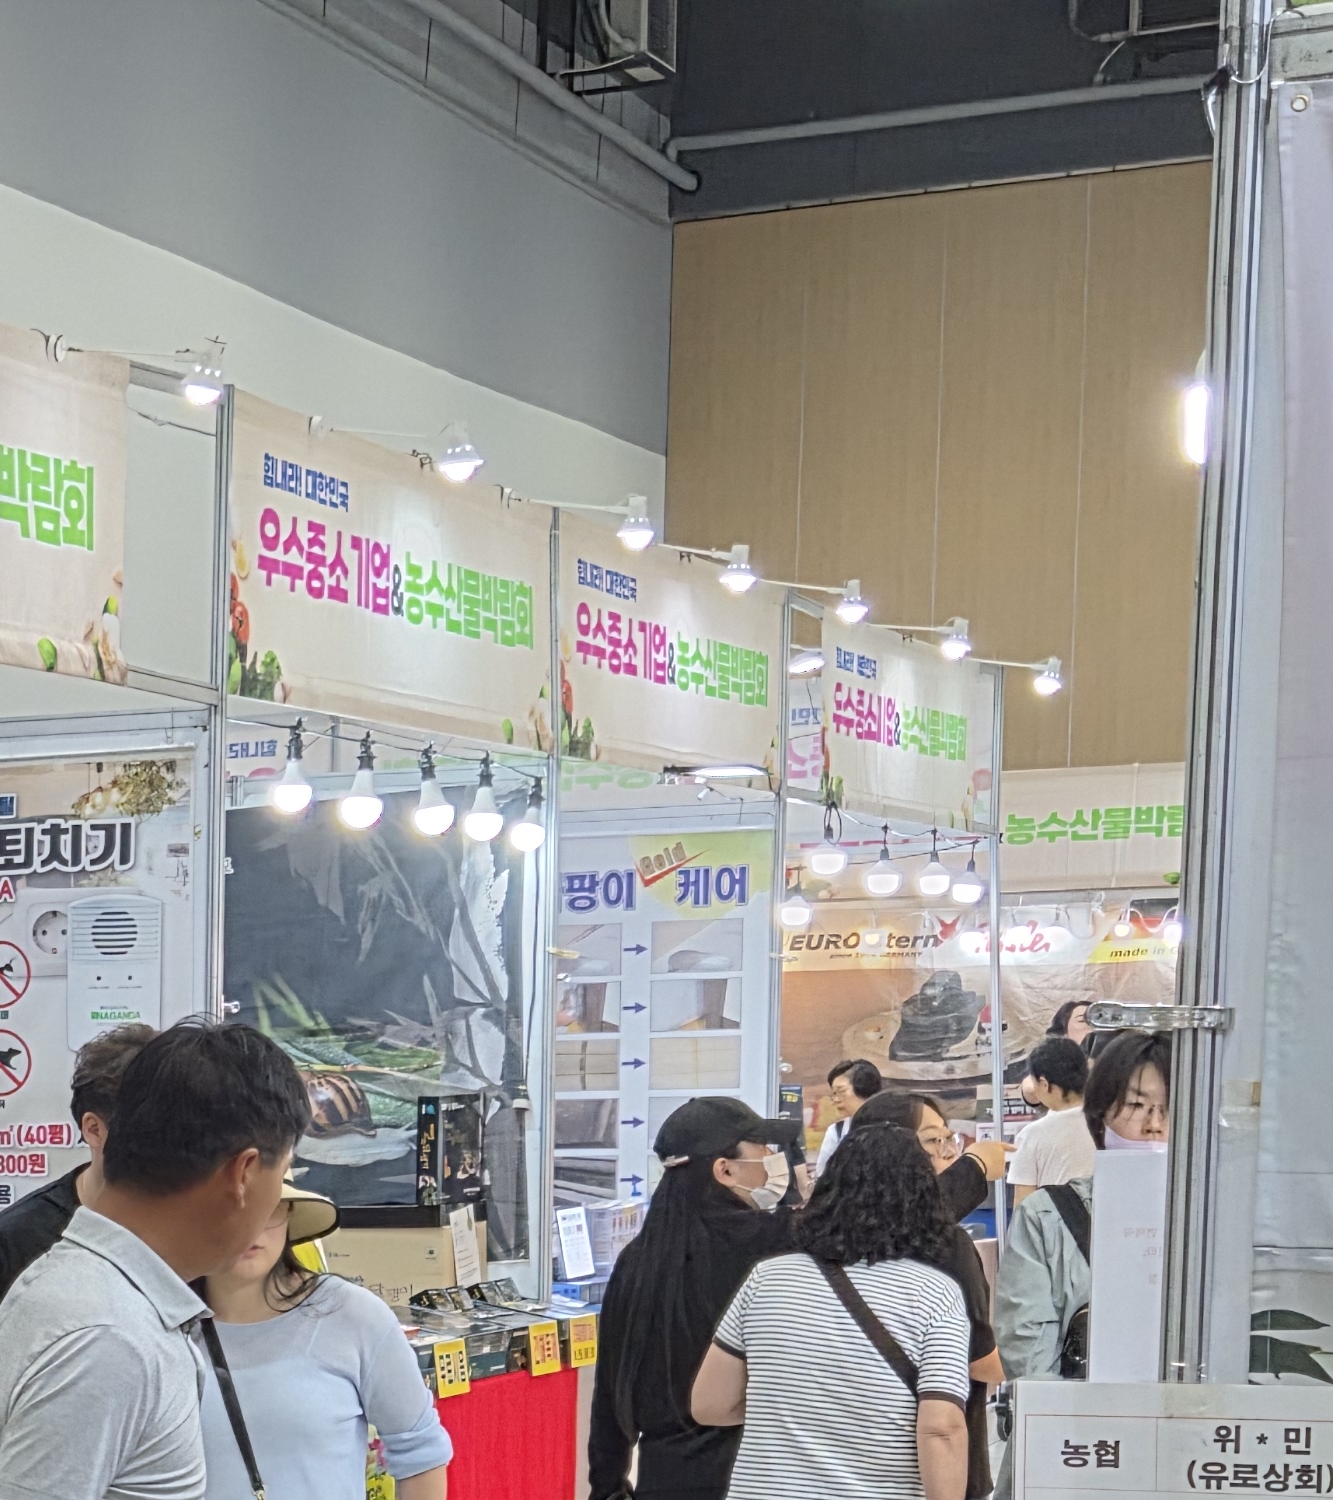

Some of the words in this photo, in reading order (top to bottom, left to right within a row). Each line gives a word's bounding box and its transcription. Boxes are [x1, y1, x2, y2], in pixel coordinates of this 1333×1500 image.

[264, 452, 302, 498] 힘내라!
[305, 470, 349, 513] 대한민국
[559, 869, 636, 914] 팡이
[674, 864, 749, 908] 케어
[789, 933, 860, 951] EURO
[885, 933, 944, 949] tern
[1060, 1439, 1121, 1469] 농협
[1187, 1459, 1333, 1494] (유로상회)
